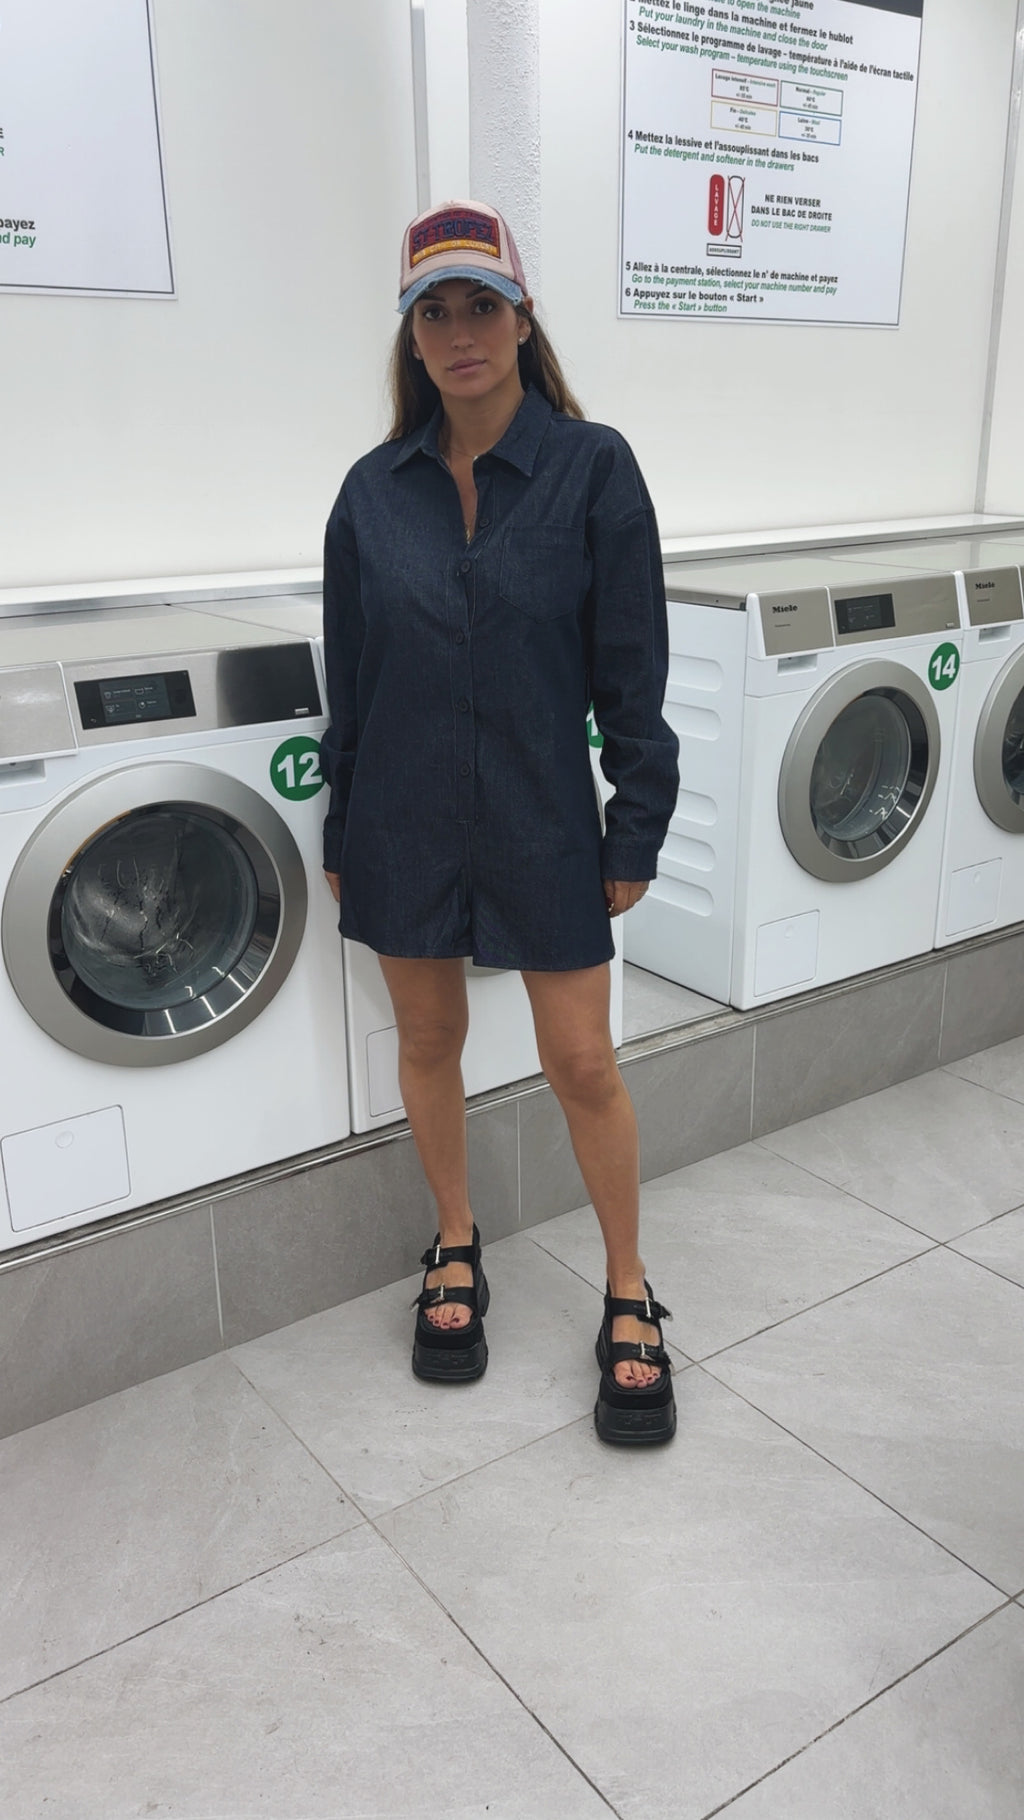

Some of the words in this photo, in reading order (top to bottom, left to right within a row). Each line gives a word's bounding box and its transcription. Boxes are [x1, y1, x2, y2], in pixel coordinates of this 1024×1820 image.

[737, 0, 755, 10] open
[757, 2, 768, 12] the
[770, 6, 800, 19] machine
[791, 0, 814, 10] jaune
[639, 6, 653, 18] Put
[655, 12, 673, 21] your
[676, 13, 706, 30] laundry
[707, 19, 714, 29] in
[716, 21, 728, 32] the
[730, 25, 761, 37] machine
[762, 32, 777, 41] and
[778, 34, 797, 45] close
[798, 36, 810, 48] the
[811, 40, 828, 51] door
[673, 0, 681, 10] le
[684, 2, 705, 16] linge
[708, 7, 728, 20] dans
[731, 11, 739, 21] la
[741, 15, 777, 29] machine
[780, 22, 788, 32] et
[790, 22, 817, 37] fermez
[820, 29, 826, 39] le
[829, 31, 853, 44] hublot
[630, 20, 635, 31] 3
[637, 21, 689, 39] Sélectionnez
[692, 32, 699, 42] le
[701, 35, 745, 50] programme
[746, 42, 756, 52] de
[758, 44, 781, 59] lavage
[789, 50, 832, 66] température
[833, 58, 838, 67] à
[859, 64, 868, 73] de
[893, 70, 914, 81] tactile
[636, 35, 660, 48] Select
[661, 40, 679, 52] your
[680, 44, 699, 55] wash
[700, 48, 730, 60] program
[737, 54, 777, 68] temperature
[779, 63, 797, 74] using
[798, 64, 808, 74] the
[810, 68, 848, 81] touchscreen
[628, 130, 633, 139] 4
[635, 131, 663, 143] Mettez
[665, 134, 672, 144] la
[675, 135, 702, 148] lessive
[704, 140, 712, 149] et
[771, 148, 788, 159] dans
[790, 151, 800, 160] les
[802, 152, 819, 163] bacs
[634, 143, 648, 154] Put
[650, 145, 662, 155] the
[664, 147, 699, 161] detergent
[701, 153, 715, 162] and
[716, 154, 745, 165] softener
[746, 156, 753, 166] in
[755, 158, 766, 168] the
[767, 160, 794, 171] drawers
[765, 194, 775, 203] NE
[776, 195, 793, 204] RIEN
[794, 197, 821, 207] VERSER
[751, 206, 770, 215] DANS
[772, 208, 780, 216] LE
[782, 209, 796, 217] BAC
[798, 210, 806, 218] DE
[808, 211, 832, 221] DROITE
[772, 221, 782, 229] USE
[784, 222, 793, 230] THE
[794, 223, 809, 231] RIGHT
[810, 224, 831, 233] DRAWER
[14, 235, 36, 248] pay
[626, 262, 630, 270] 5
[633, 262, 652, 272] Allez
[654, 263, 659, 272] à
[662, 264, 668, 273] la
[670, 265, 704, 276] centrale,
[706, 266, 751, 278] sélectionnez
[753, 269, 760, 278] le
[770, 270, 779, 279] de
[781, 272, 809, 280] machine
[819, 275, 838, 284] payez
[625, 288, 630, 296] 6
[633, 288, 670, 300] Appuyez
[672, 291, 686, 299] sur
[689, 291, 696, 299] le
[699, 291, 727, 301] bouton
[736, 293, 757, 302] Start
[632, 274, 642, 283] Go
[644, 275, 651, 284] to
[653, 275, 664, 284] the
[665, 277, 696, 287] payment
[698, 278, 721, 288] station,
[724, 279, 744, 289] select
[744, 282, 759, 291] your
[760, 282, 787, 291] machine
[788, 284, 812, 292] number
[813, 285, 825, 293] and
[825, 286, 837, 296] pay
[633, 299, 656, 310] Press
[658, 300, 670, 310] the
[678, 301, 696, 311] Start
[703, 303, 727, 312] button
[975, 582, 995, 590] Miele
[772, 604, 798, 613] Miele
[932, 654, 956, 680] 14
[277, 752, 322, 788] 12
